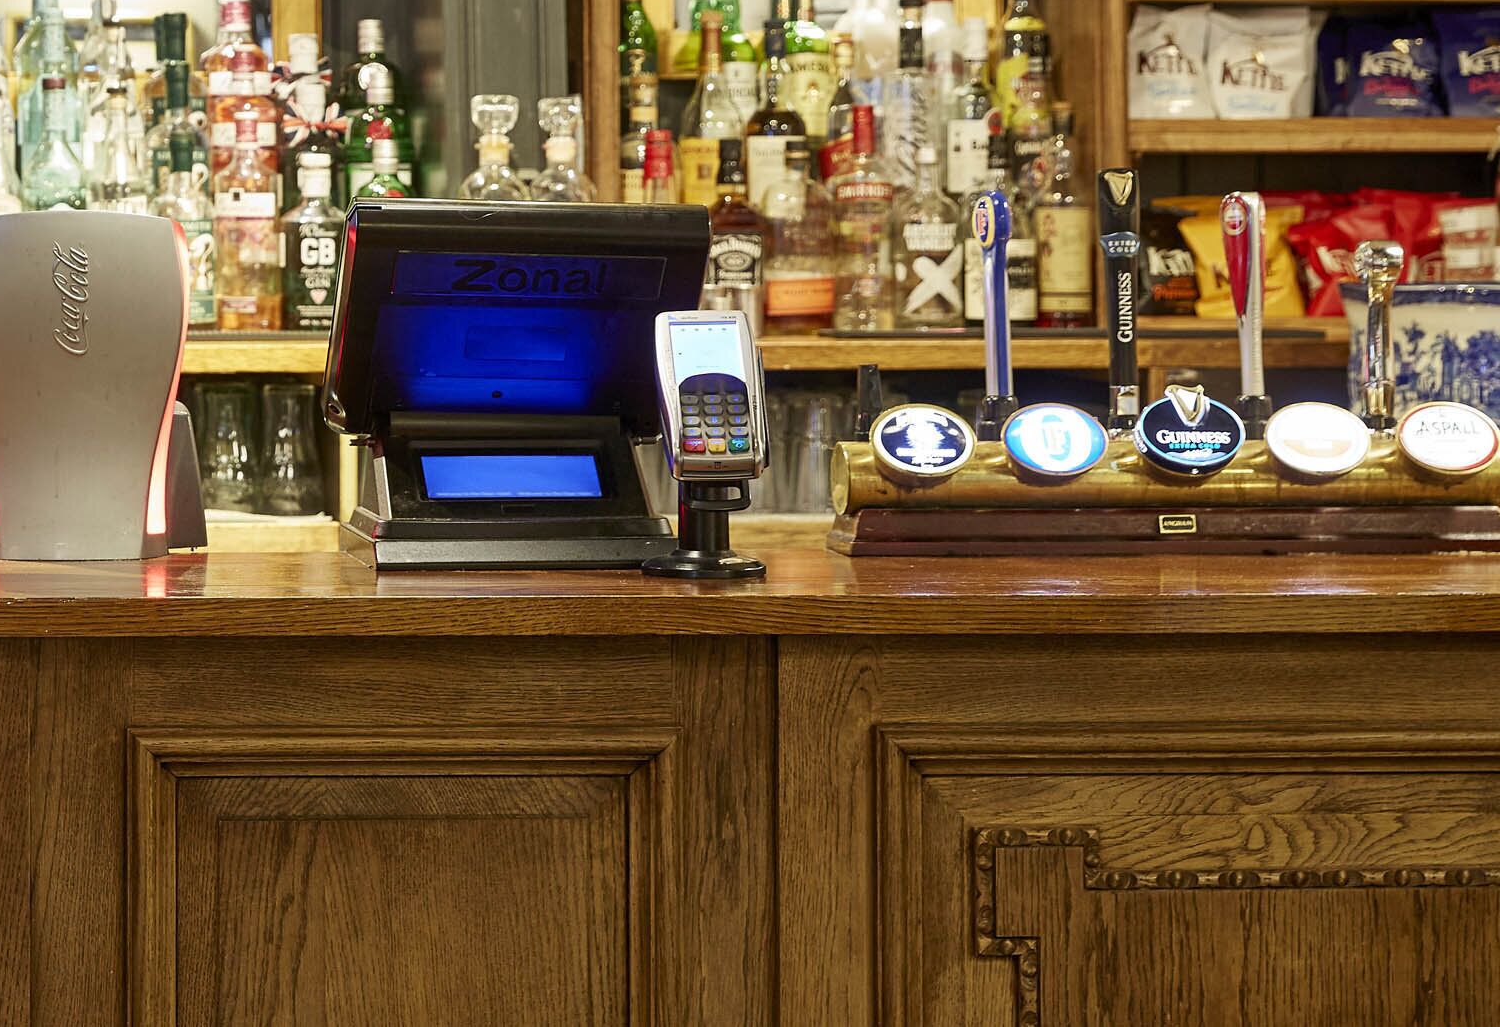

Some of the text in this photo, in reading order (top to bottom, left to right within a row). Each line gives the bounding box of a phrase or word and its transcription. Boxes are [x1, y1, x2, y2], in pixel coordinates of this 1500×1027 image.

[300, 237, 336, 266] GB
[1108, 239, 1137, 247] EXTRA
[452, 259, 608, 293] Zonal
[1117, 272, 1133, 343] GUINNESS
[1155, 429, 1232, 444] GUINNESS
[1415, 420, 1479, 436] ASPALL
